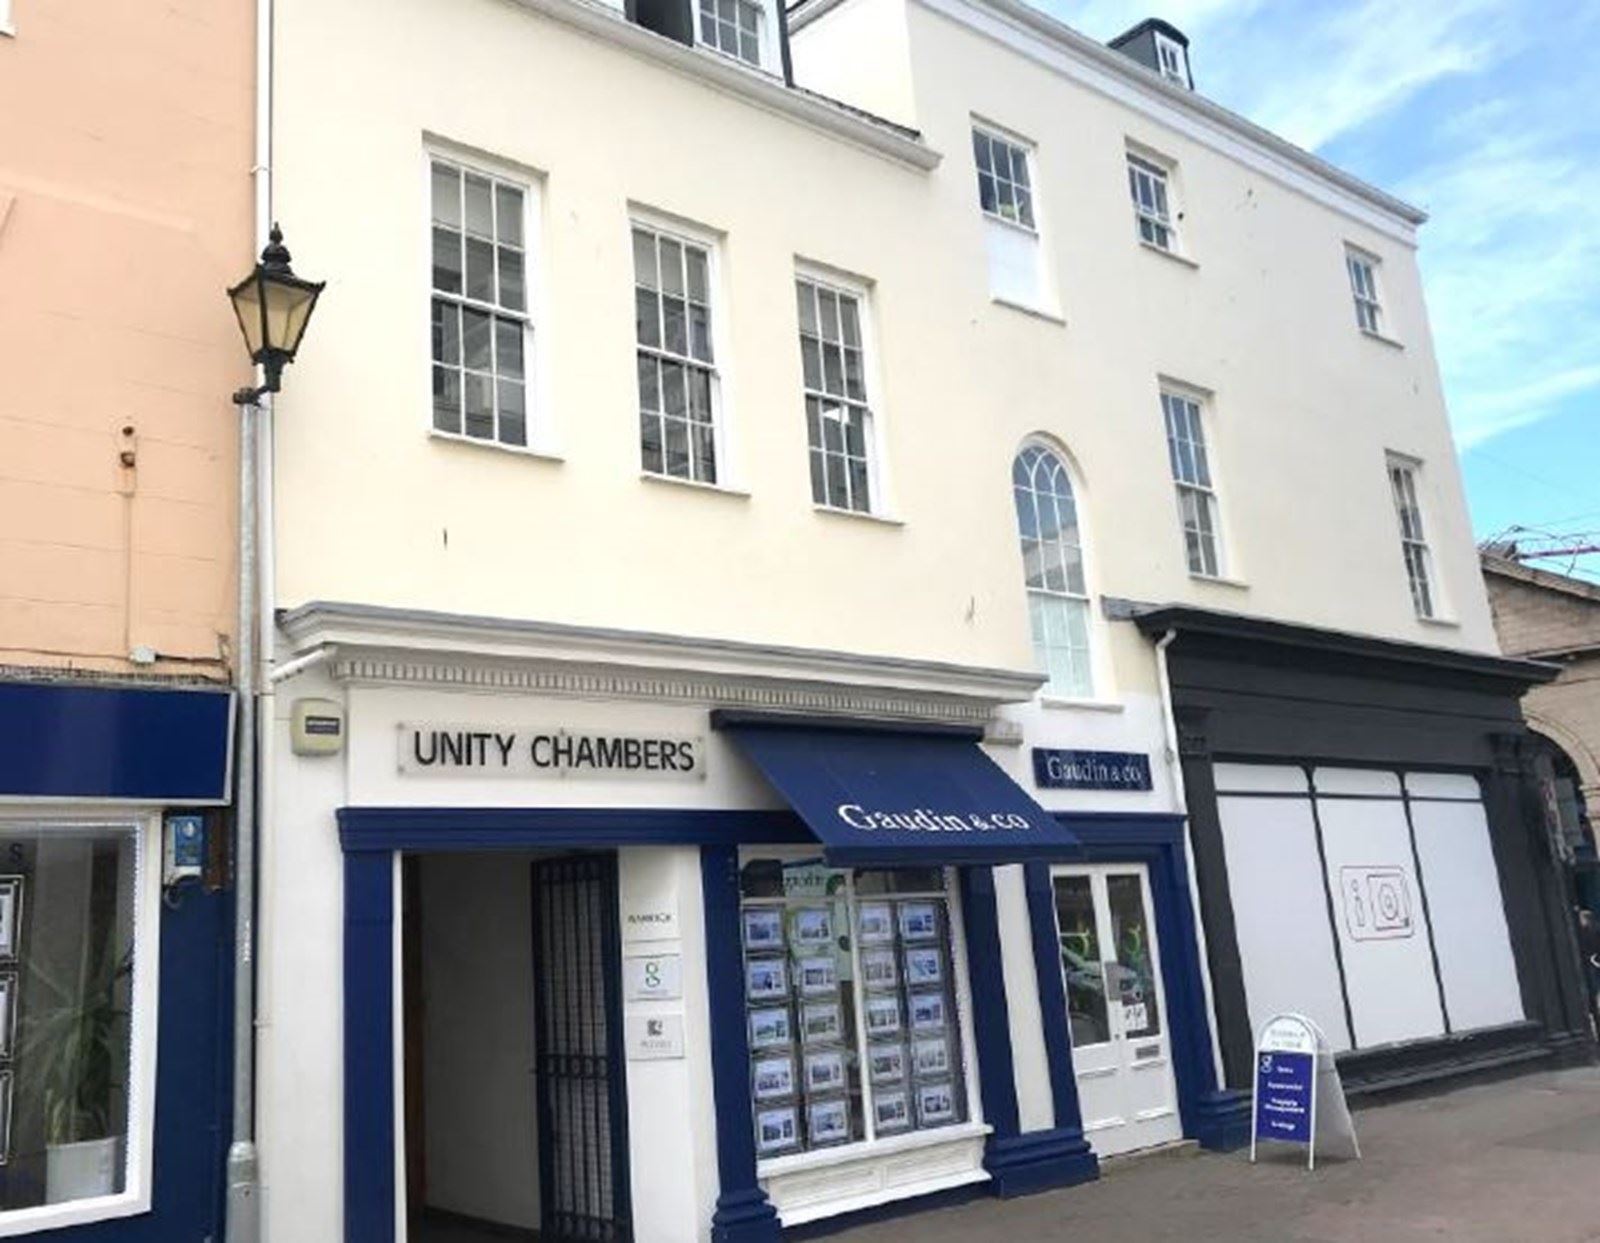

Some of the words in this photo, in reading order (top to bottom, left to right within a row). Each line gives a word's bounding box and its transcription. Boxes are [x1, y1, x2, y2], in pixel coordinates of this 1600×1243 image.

[414, 730, 516, 768] UNITY
[530, 735, 695, 772] CHAMBERS
[1046, 756, 1108, 782] Gaudin
[1121, 765, 1142, 782] co
[837, 804, 973, 832] Gaudin
[990, 813, 1030, 830] co
